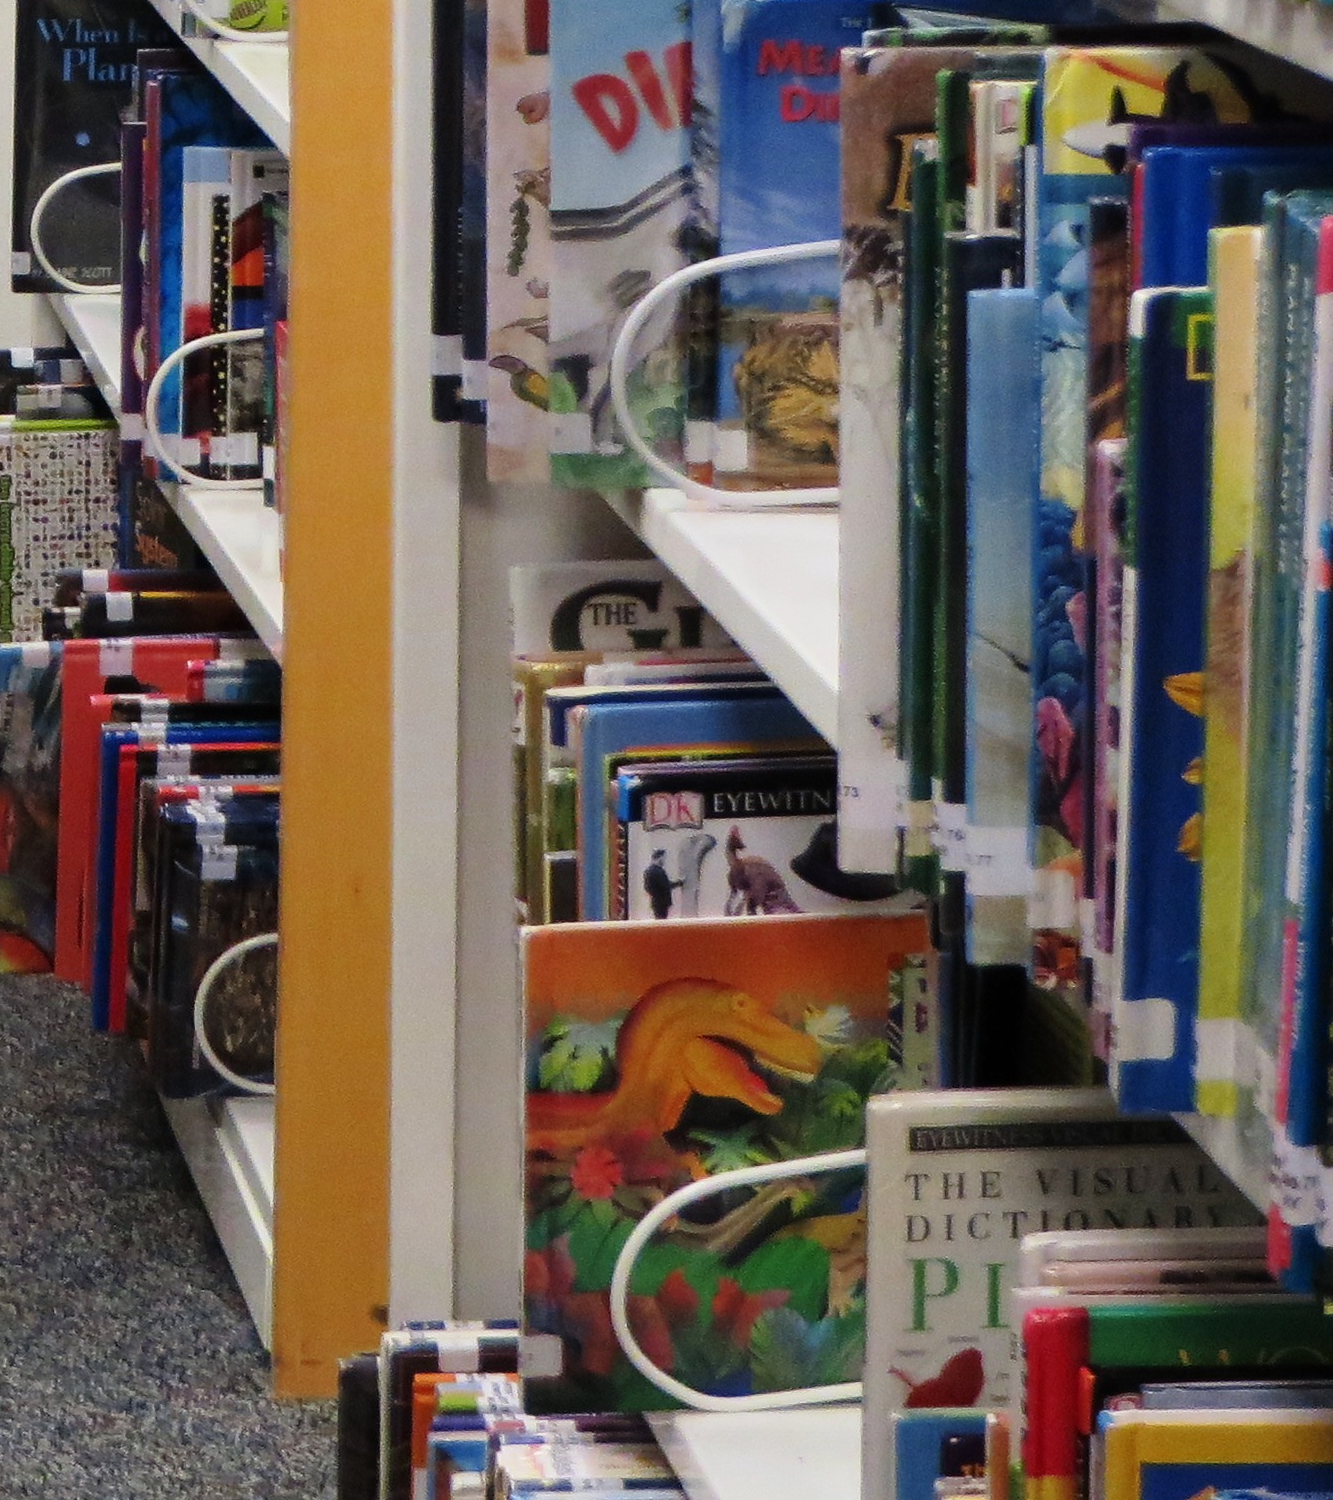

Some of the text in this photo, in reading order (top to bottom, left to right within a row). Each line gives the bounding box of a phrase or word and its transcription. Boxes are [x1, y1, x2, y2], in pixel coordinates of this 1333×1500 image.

[37, 16, 119, 43] When
[588, 602, 637, 626] THE
[647, 789, 831, 826] DK EYEWITN
[904, 1163, 1221, 1201] THE VISUAL
